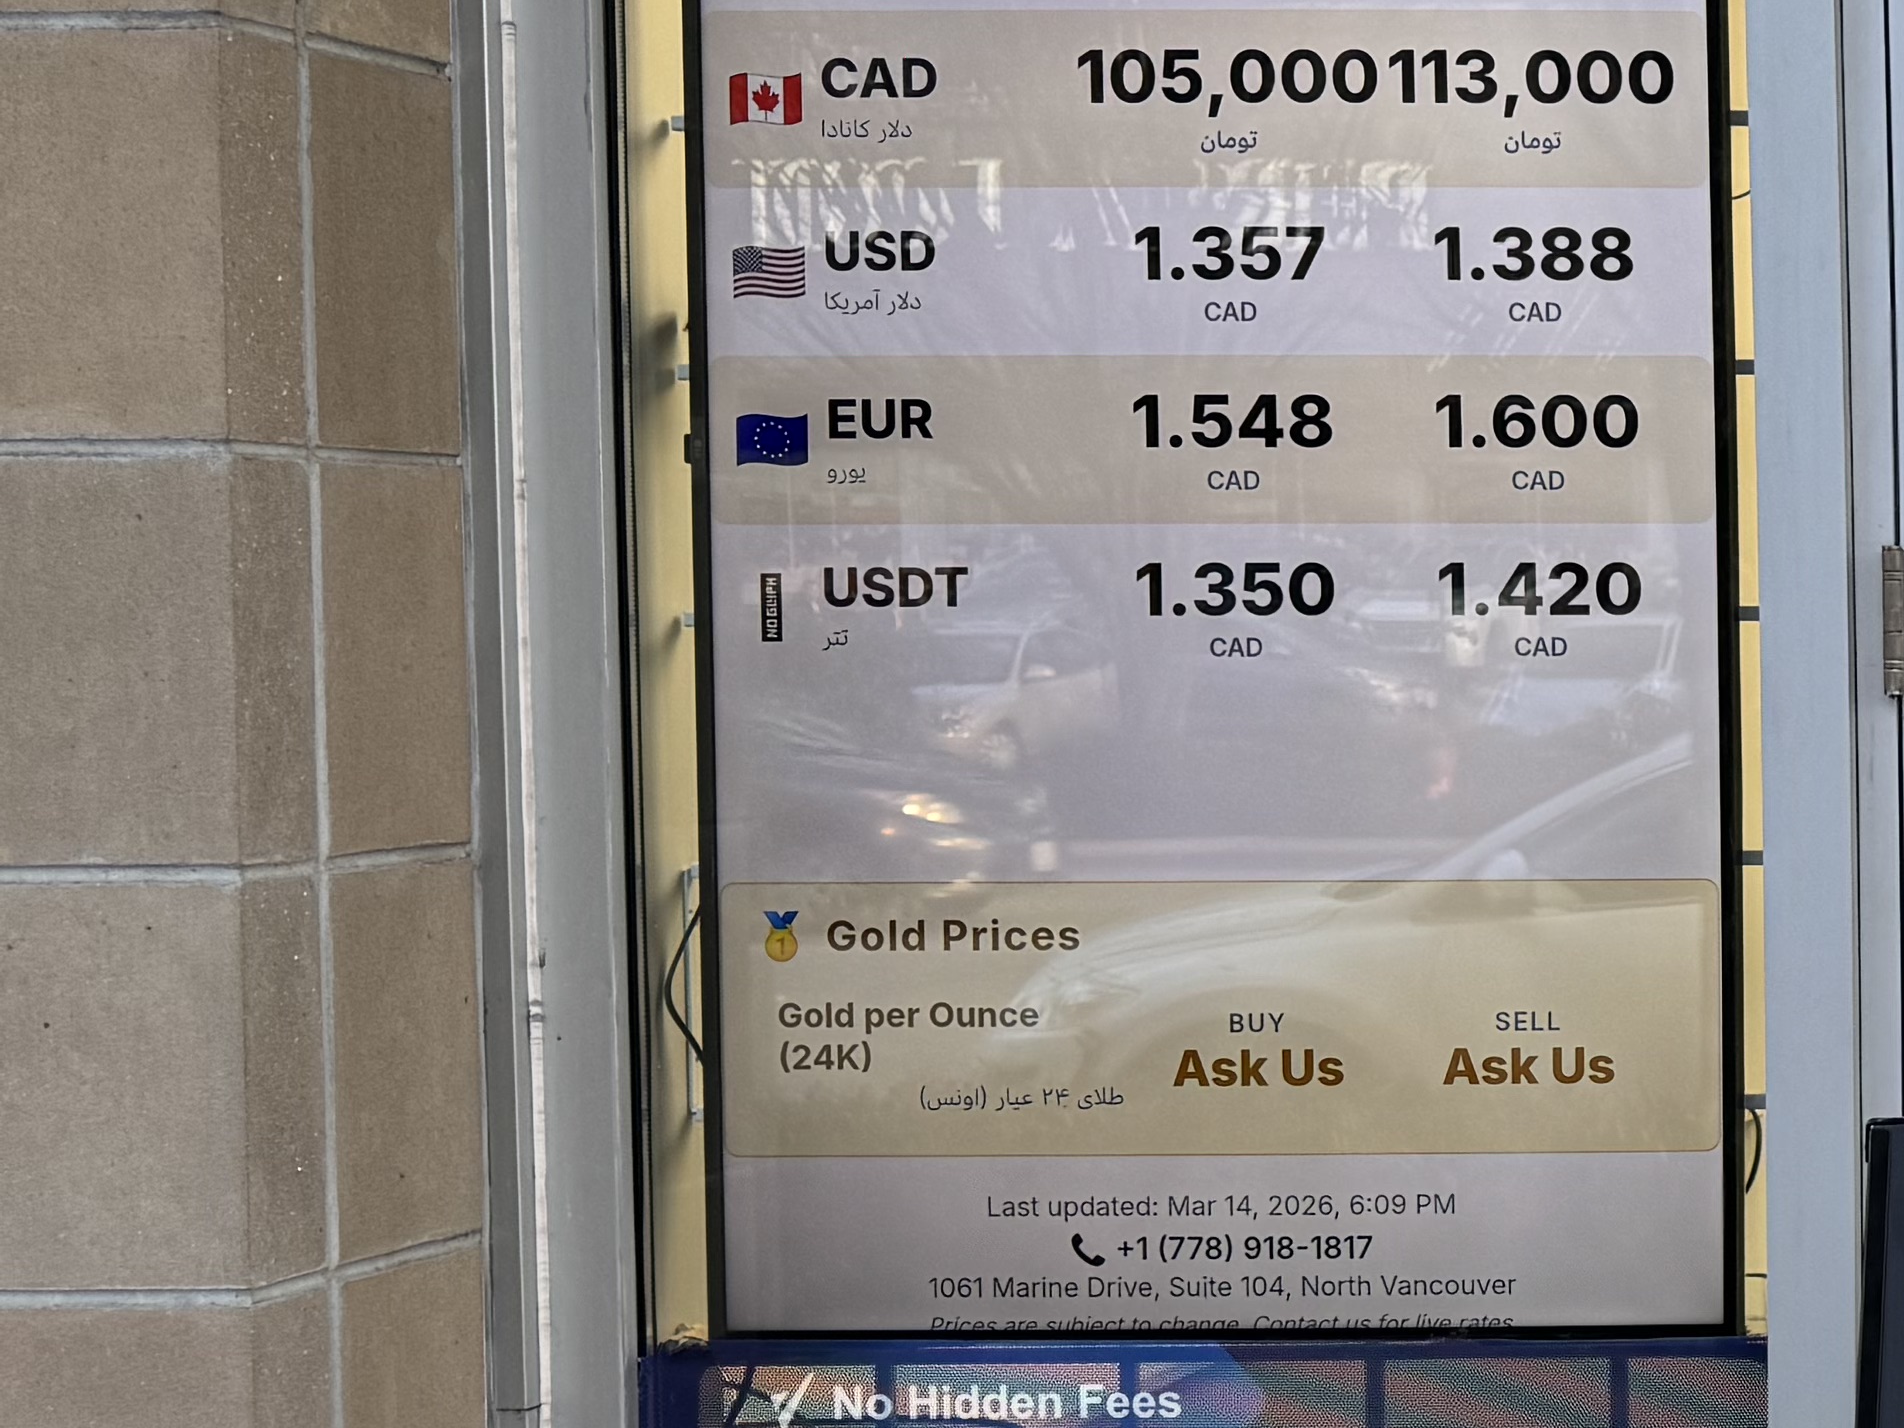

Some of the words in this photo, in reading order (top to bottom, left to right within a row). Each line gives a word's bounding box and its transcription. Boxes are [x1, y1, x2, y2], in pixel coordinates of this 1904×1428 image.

[822, 58, 936, 98] CAD
[1078, 49, 1377, 117] 105,000
[1389, 50, 1673, 118] 113,000
[822, 120, 870, 137] کانادا
[878, 120, 912, 143] دلار
[1201, 131, 1257, 153] تومان
[1505, 131, 1560, 154] تومان
[826, 231, 935, 271] USD
[1135, 226, 1324, 280] 1.357
[1435, 227, 1633, 280] 1.388
[824, 289, 881, 317] آمریکا
[887, 291, 921, 315] دلار
[1205, 302, 1256, 321] CAD
[1509, 302, 1561, 322] CAD
[829, 399, 932, 439] EUR
[1133, 395, 1332, 447] 1.548
[1436, 395, 1638, 448] 1.600
[827, 468, 866, 484] یورو
[1208, 471, 1259, 490] CAD
[1512, 471, 1564, 490] CAD
[824, 567, 968, 607] USDT
[1137, 563, 1334, 616] 1.350
[1439, 562, 1641, 615] 1.420
[822, 630, 848, 650] تتر
[1210, 638, 1262, 657] CAD
[1515, 637, 1567, 656] CAD
[828, 920, 924, 951] Gold
[943, 919, 1079, 951] Prices
[779, 1002, 853, 1028] Gold
[866, 1008, 920, 1034] per
[930, 1002, 1038, 1027] Ounce
[1230, 1013, 1284, 1032] BUY
[1496, 1011, 1560, 1031] SELL
[781, 1041, 871, 1073] (24K)
[1173, 1049, 1268, 1086] Ask
[1282, 1049, 1344, 1086] Us
[1443, 1048, 1538, 1085] Ask
[1553, 1047, 1614, 1084] Us
[996, 1088, 1032, 1111] عیار
[1043, 1089, 1069, 1105] ۲۴
[1078, 1087, 1123, 1109] طلای
[988, 1196, 1039, 1217] Last
[1049, 1196, 1157, 1222] updated:
[1169, 1196, 1216, 1216] Mar
[1225, 1195, 1257, 1220] 14,
[1269, 1195, 1338, 1219] 2026,
[1350, 1195, 1405, 1215] 6:09
[1417, 1194, 1454, 1214] PM
[1118, 1237, 1147, 1260] +1
[1160, 1234, 1232, 1263] (778)
[1244, 1236, 1372, 1259] 918-1817
[929, 1278, 982, 1298] 1061
[993, 1277, 1078, 1298] Marine
[1088, 1277, 1159, 1301] Drive,
[1170, 1276, 1231, 1298] Suite
[1241, 1276, 1290, 1301] 104,
[1302, 1276, 1370, 1296] North
[1381, 1275, 1516, 1295] Vancouver
[931, 1316, 996, 1329] Prices
[1004, 1320, 1038, 1329] are
[1132, 1316, 1152, 1329] to
[1254, 1315, 1338, 1329] Contact
[1344, 1319, 1370, 1329] us
[1378, 1314, 1410, 1328] for
[1416, 1314, 1452, 1328] live
[1459, 1315, 1514, 1328] rates
[831, 1384, 893, 1420] No
[908, 1383, 1063, 1422] Hidden
[1078, 1384, 1182, 1419] Fees
